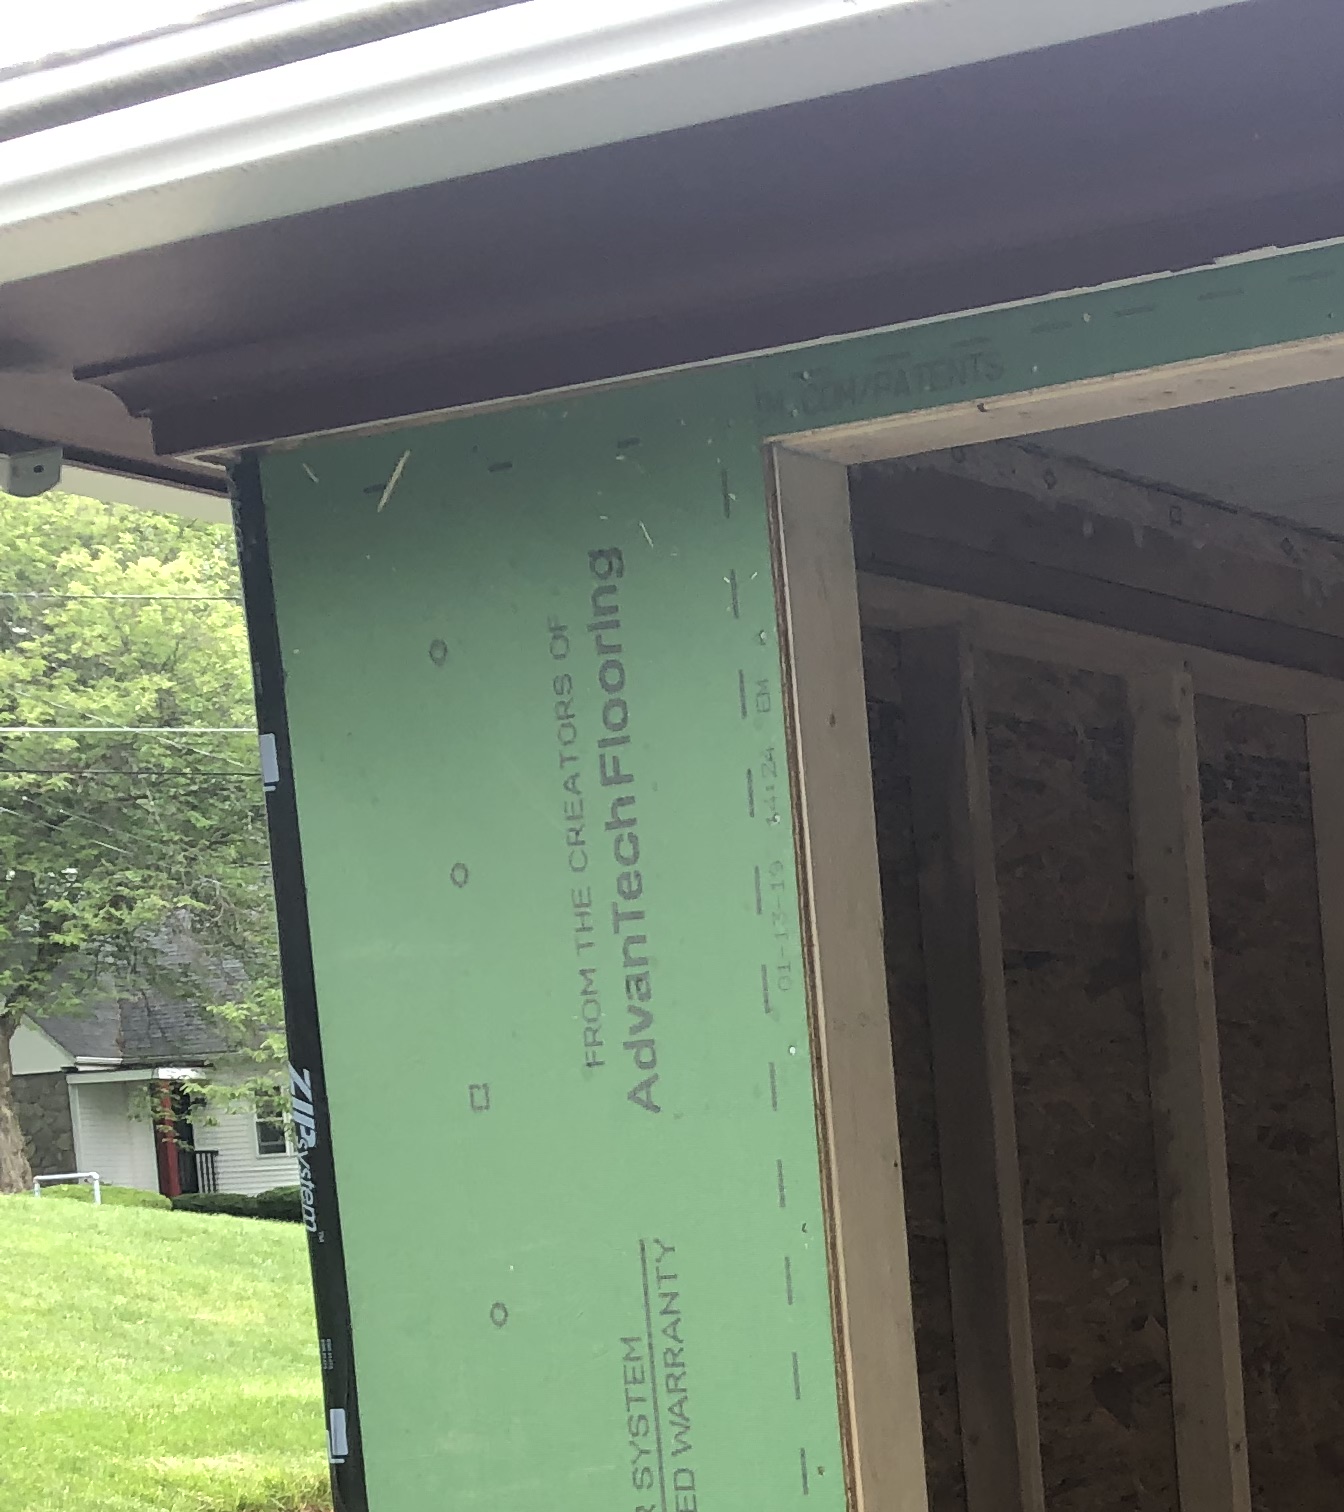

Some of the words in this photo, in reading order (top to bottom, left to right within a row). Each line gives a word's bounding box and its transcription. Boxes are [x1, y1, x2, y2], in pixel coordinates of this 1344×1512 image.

[547, 614, 570, 658] OF
[553, 672, 588, 872] CREATORS
[572, 885, 592, 950] THE
[581, 966, 604, 1068] FROM
[654, 1238, 694, 1453] WARRANTY
[620, 1336, 653, 1490] SYSTEM
